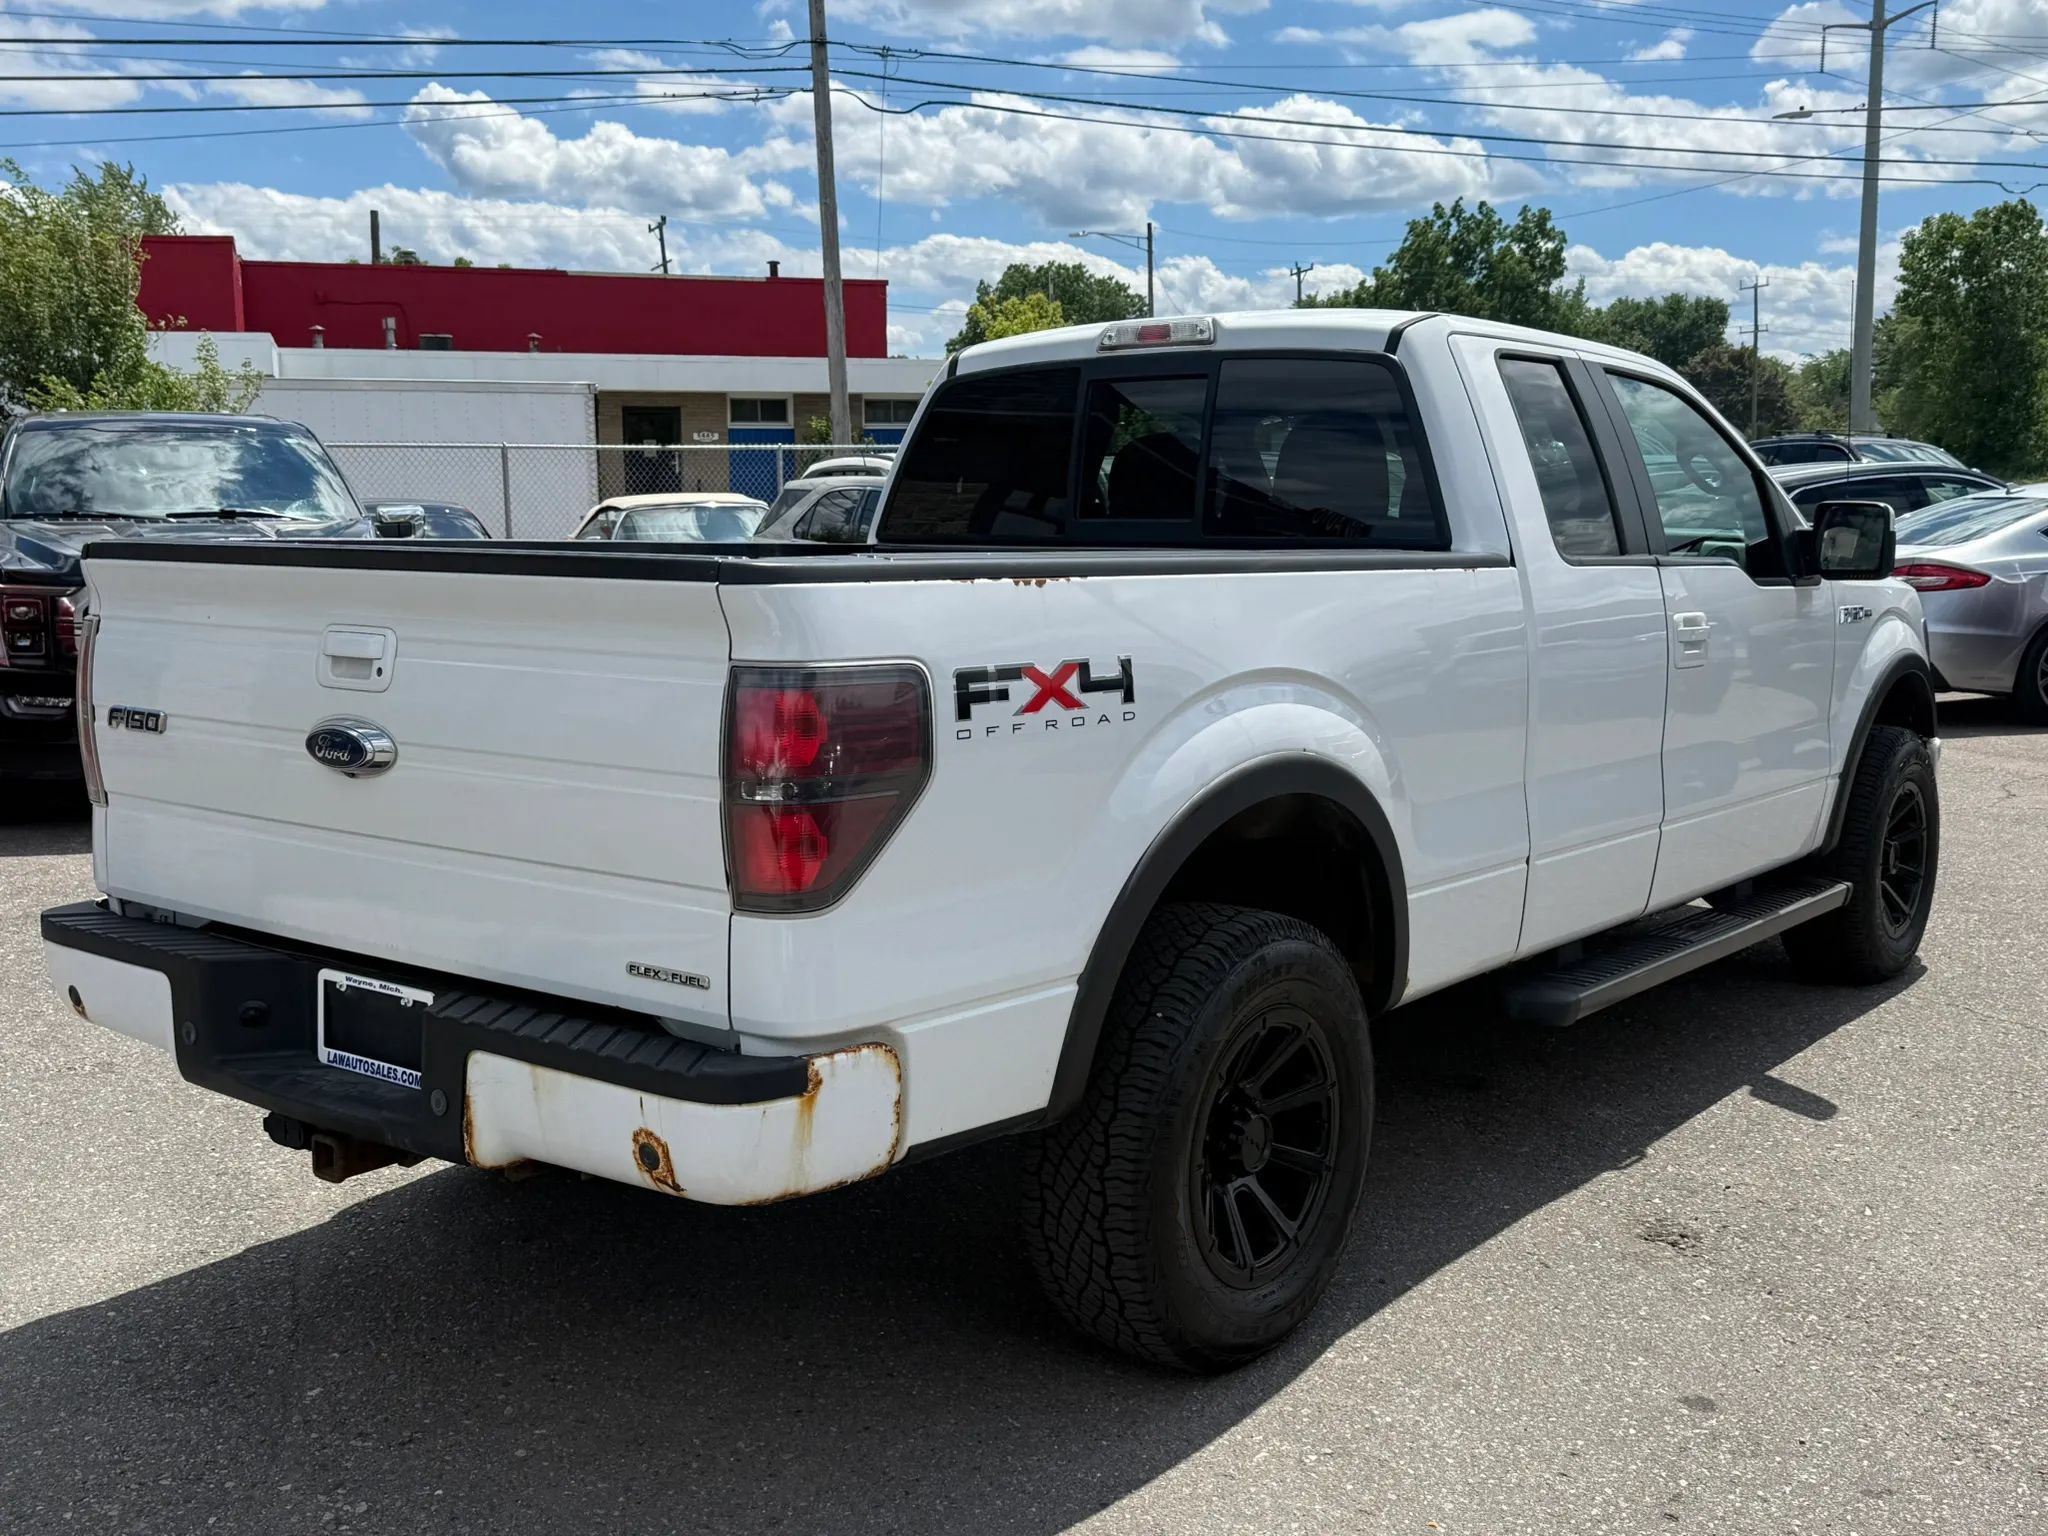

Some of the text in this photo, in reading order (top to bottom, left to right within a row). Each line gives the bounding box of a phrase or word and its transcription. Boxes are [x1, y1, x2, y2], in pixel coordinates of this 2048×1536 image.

[954, 655, 1135, 721] FX4
[956, 711, 1136, 740] OFF ROAD
[315, 734, 352, 761] Ford
[379, 983, 403, 994] Mich.
[629, 964, 706, 988] FLEX FUEL
[327, 1051, 422, 1087] LAWAUTOSALES.COM
